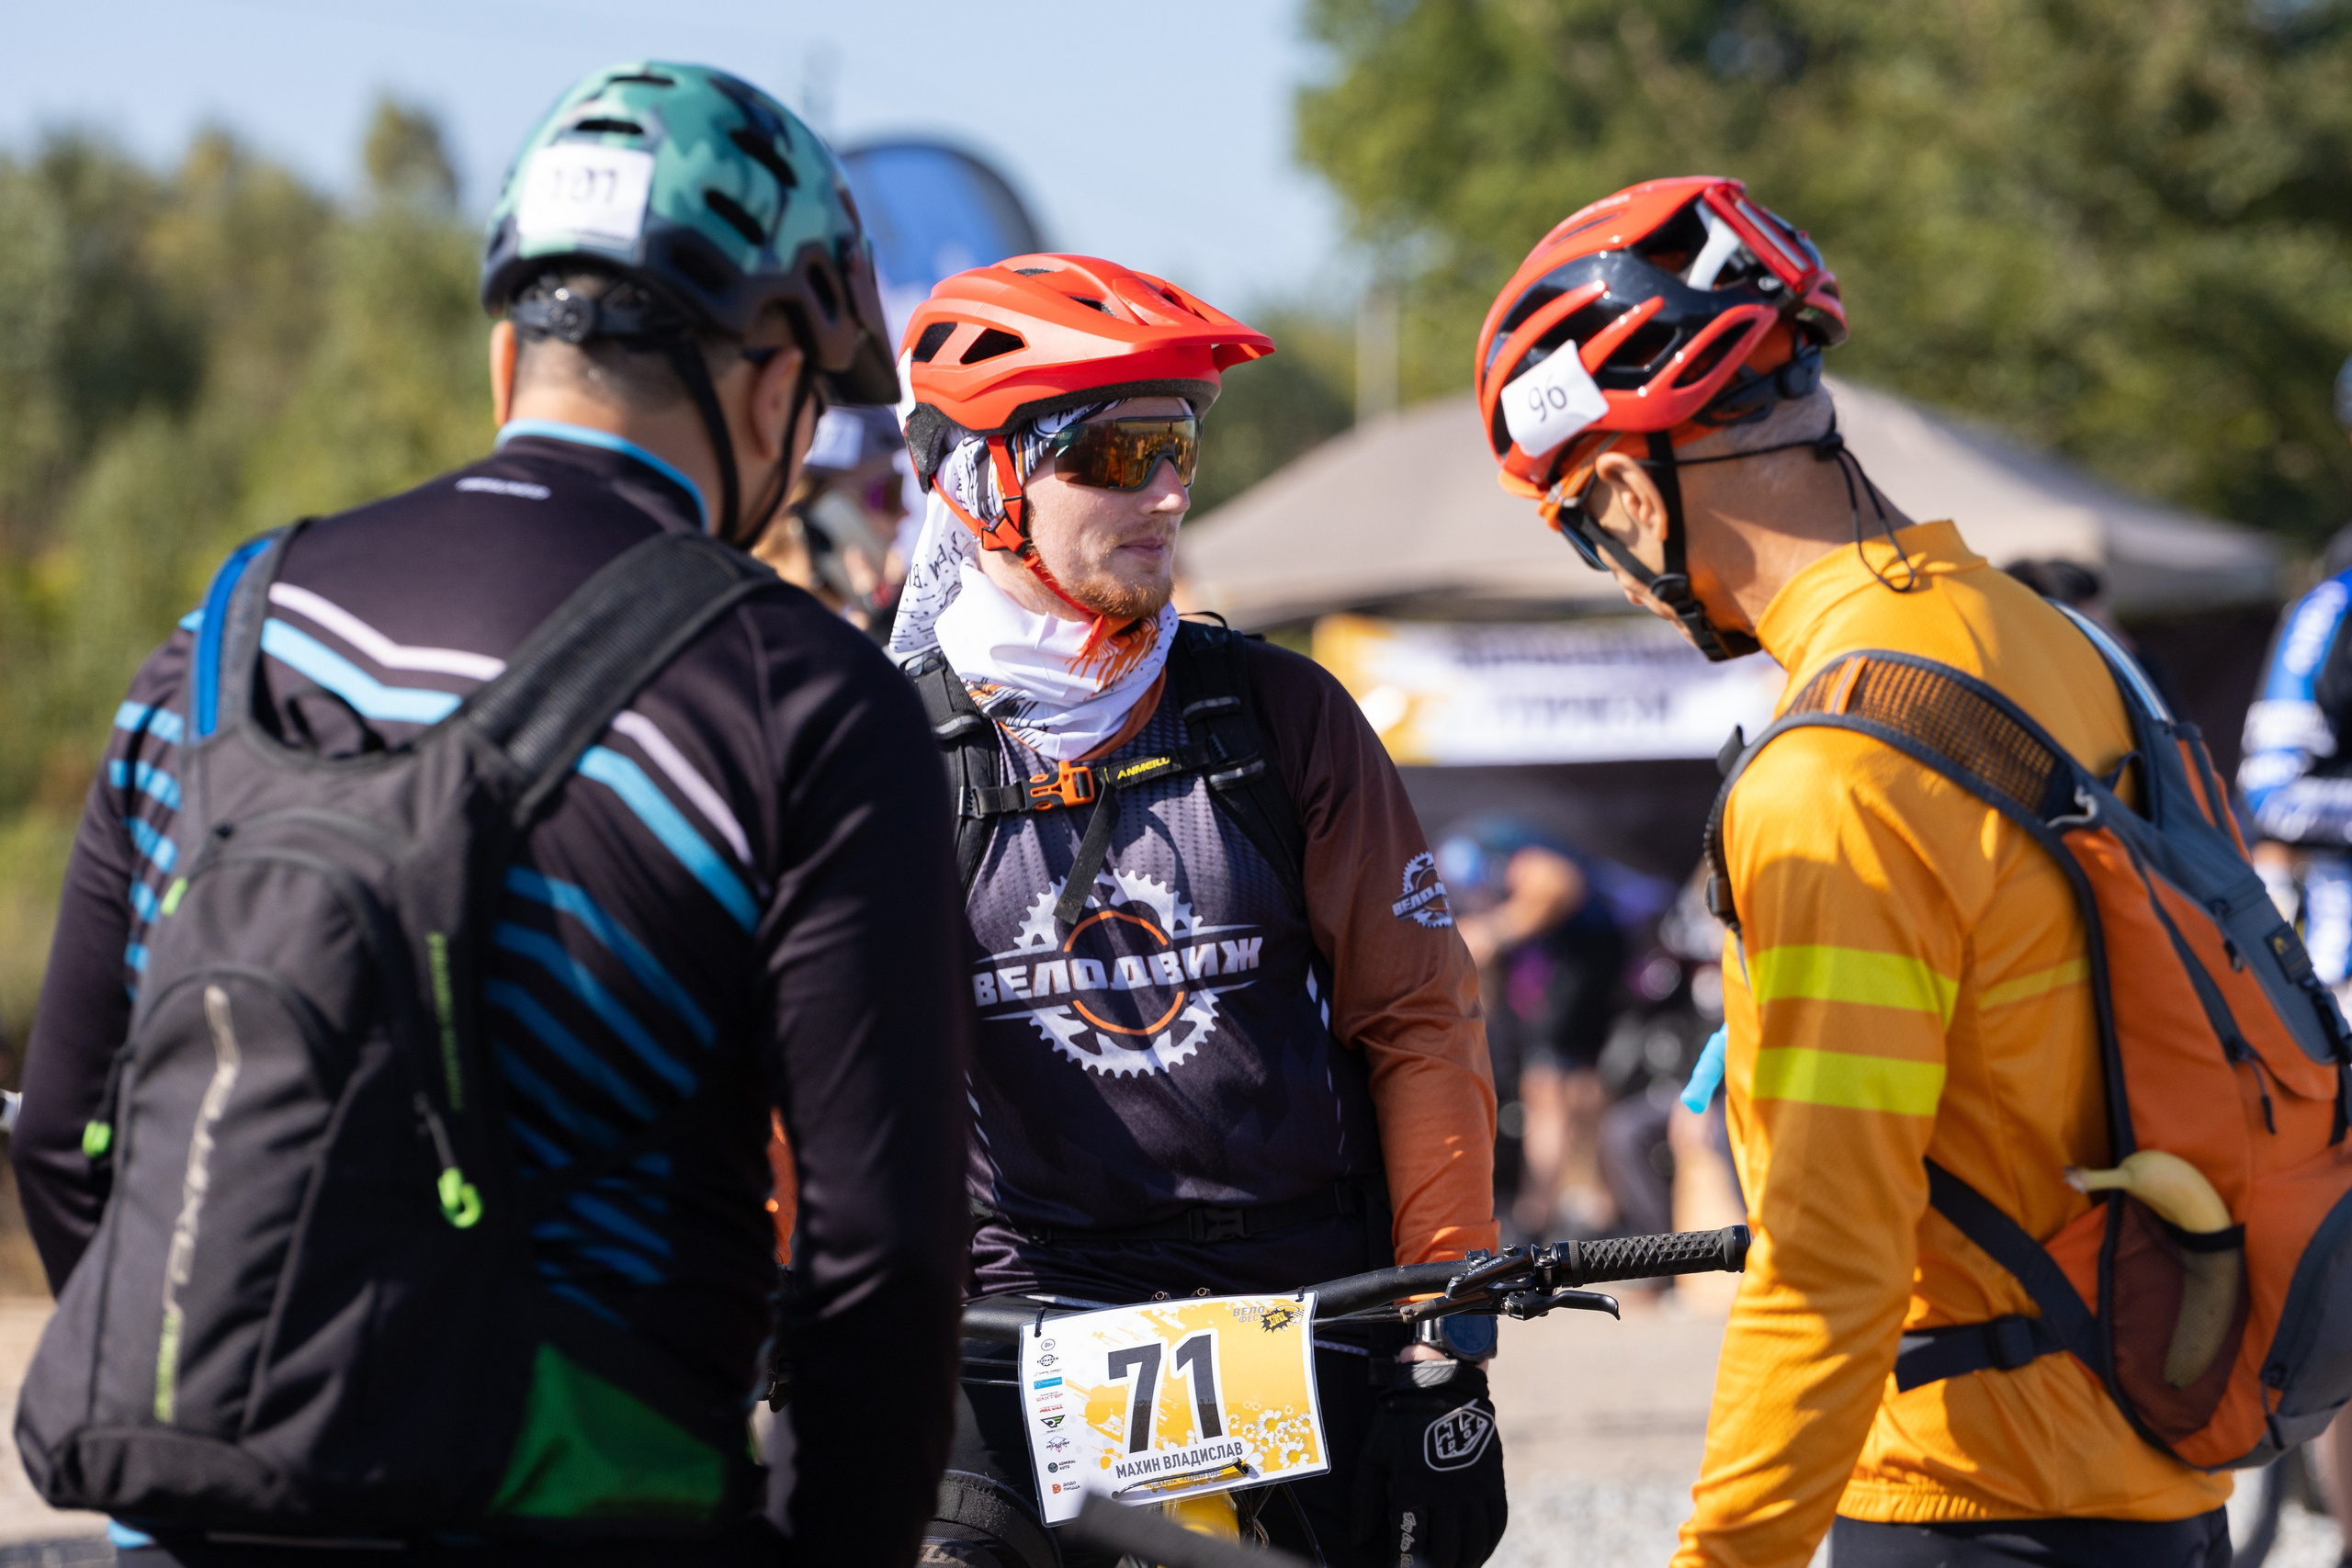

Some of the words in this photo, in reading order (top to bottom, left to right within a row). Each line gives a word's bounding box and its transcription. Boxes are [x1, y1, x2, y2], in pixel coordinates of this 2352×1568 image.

[1528, 374, 1567, 423] 96
[971, 936, 1263, 1007] ВЕЛОДВИЖ
[1467, 1257, 1503, 1276] DEORE
[1232, 1305, 1265, 1317] ВЕЛО
[1108, 1334, 1223, 1454] 71
[1115, 1457, 1160, 1479] МАХИН
[1163, 1441, 1243, 1472] ВЛАДИСЛАВ
